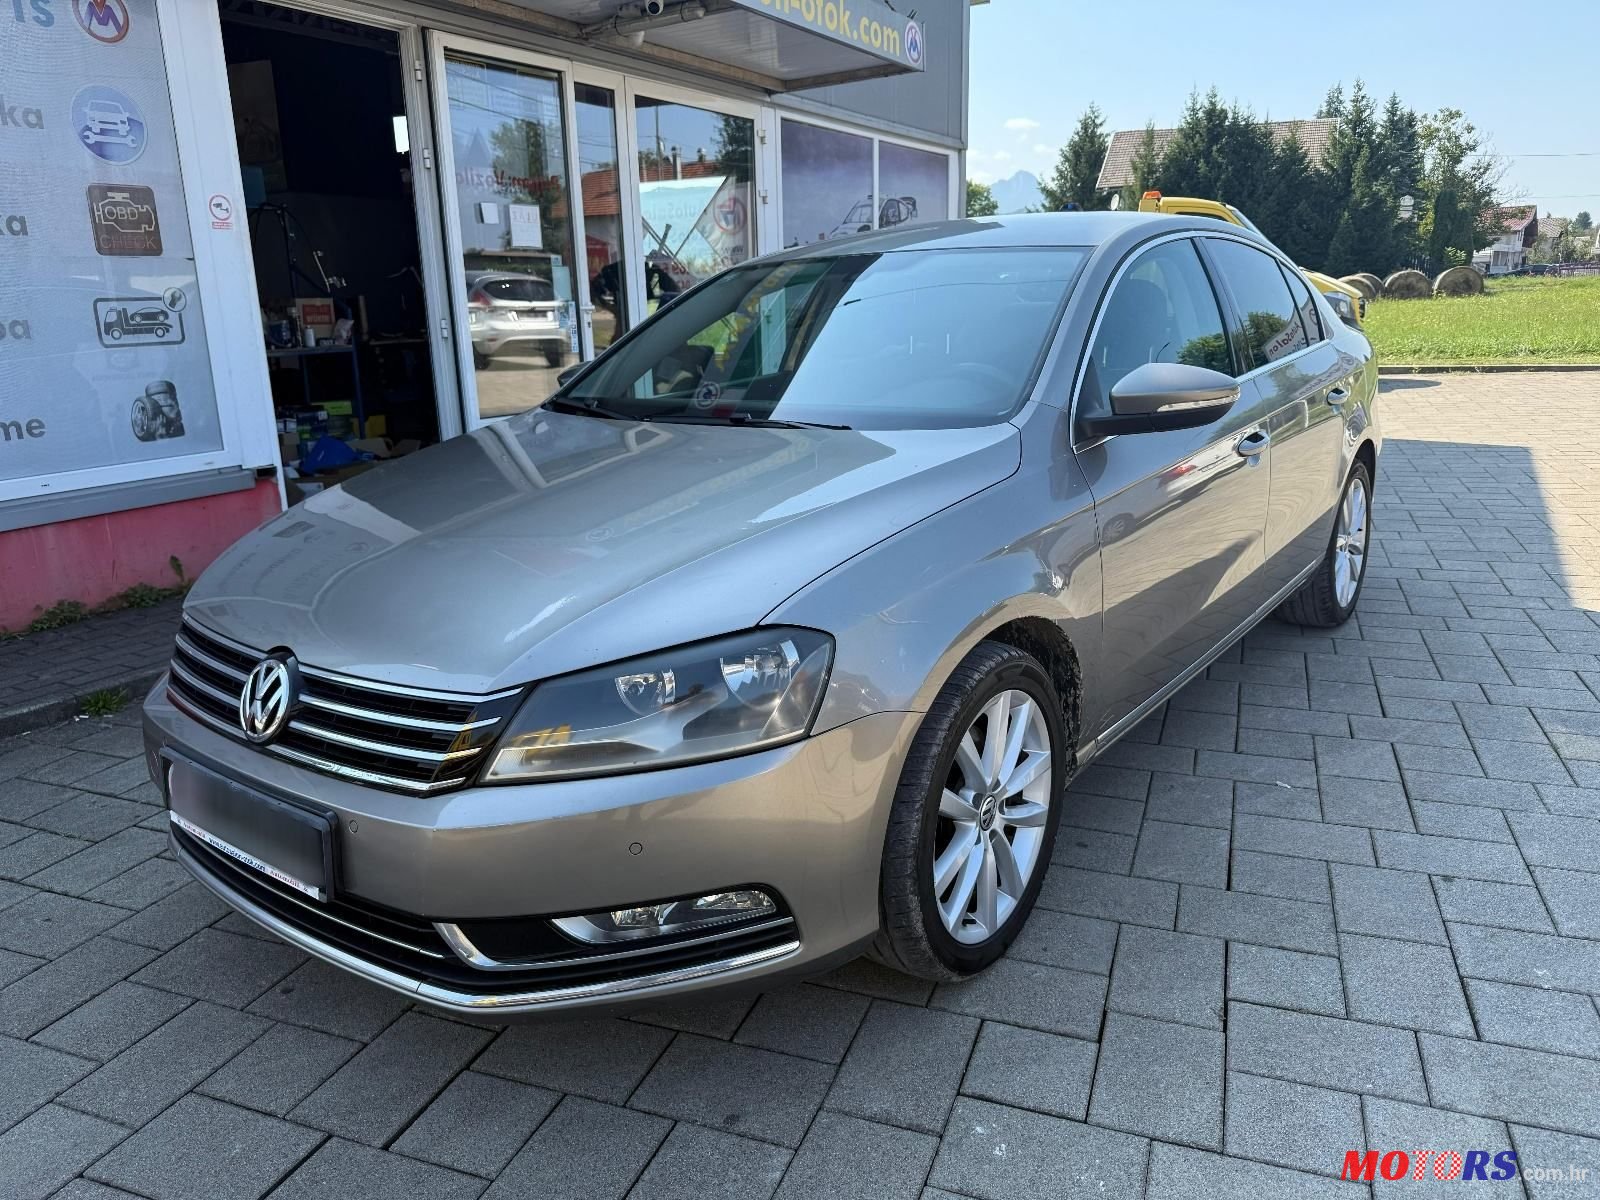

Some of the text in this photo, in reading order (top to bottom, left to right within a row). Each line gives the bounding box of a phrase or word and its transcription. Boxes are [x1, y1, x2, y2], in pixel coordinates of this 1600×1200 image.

[760, 0, 900, 57] -otok.com
[105, 206, 138, 220] OBD
[0, 214, 28, 236] a
[100, 234, 158, 249] CHECK
